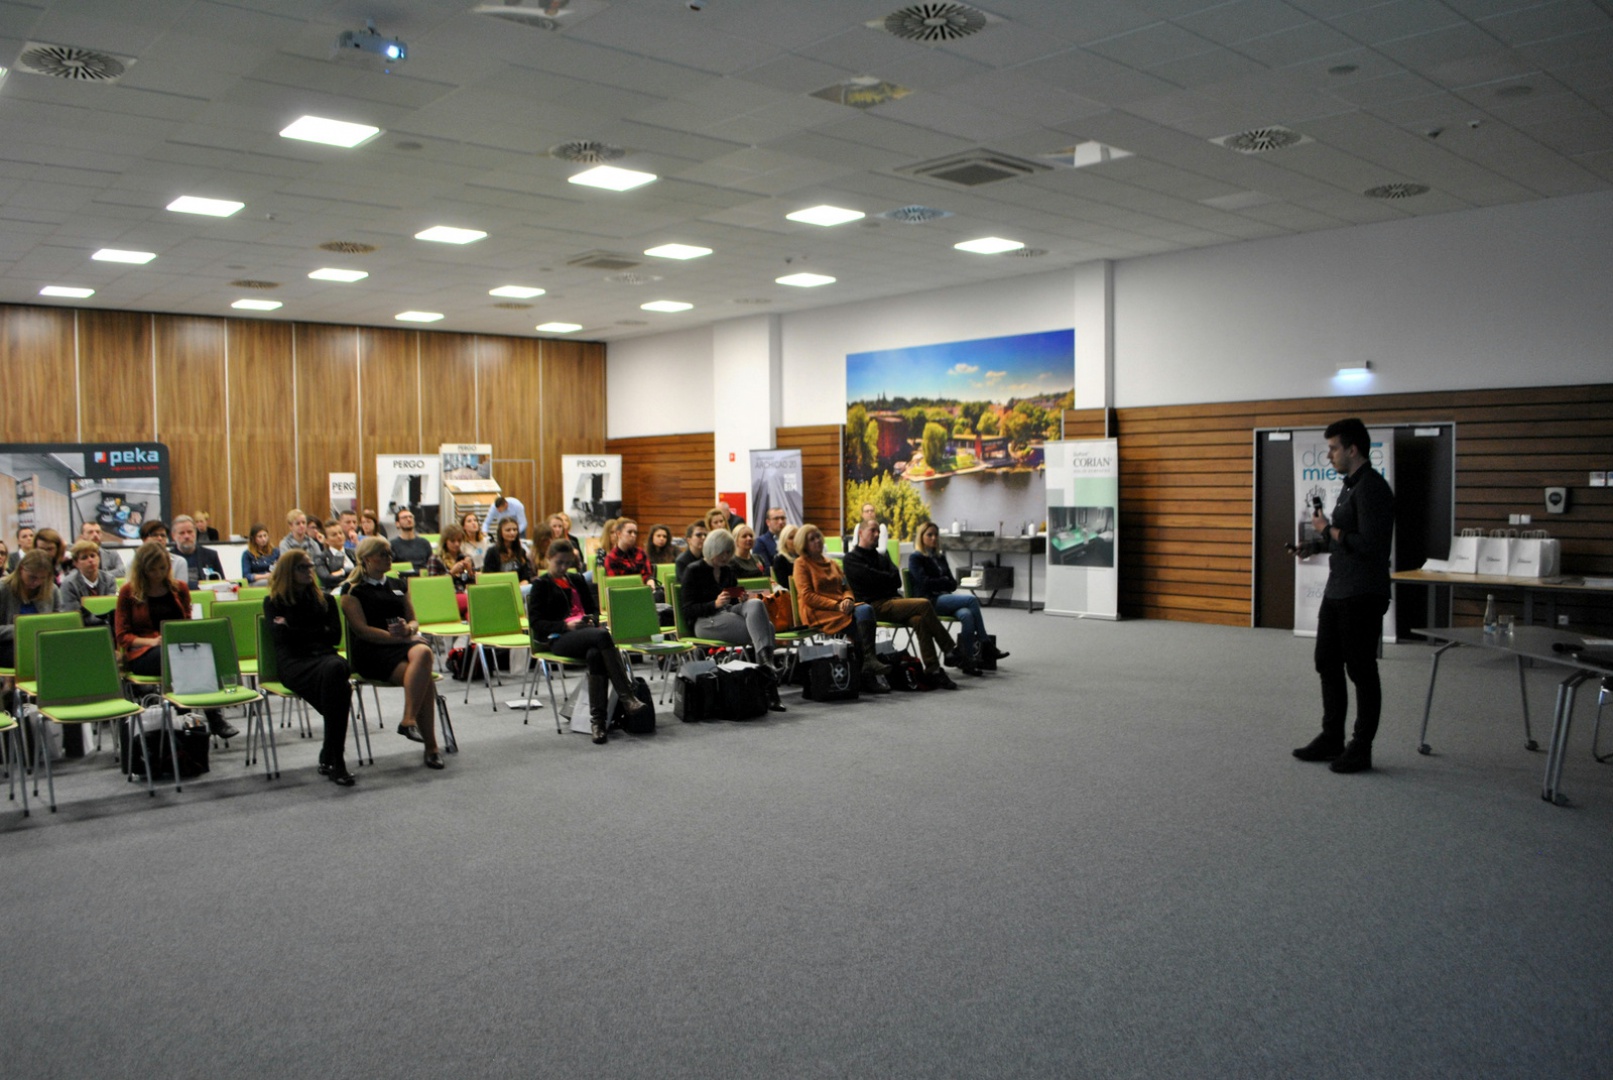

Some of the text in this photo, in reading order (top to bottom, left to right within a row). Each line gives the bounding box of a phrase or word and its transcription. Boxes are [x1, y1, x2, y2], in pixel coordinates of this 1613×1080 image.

[110, 447, 159, 467] peka
[393, 460, 425, 469] PERGO
[577, 459, 607, 468] PERGO
